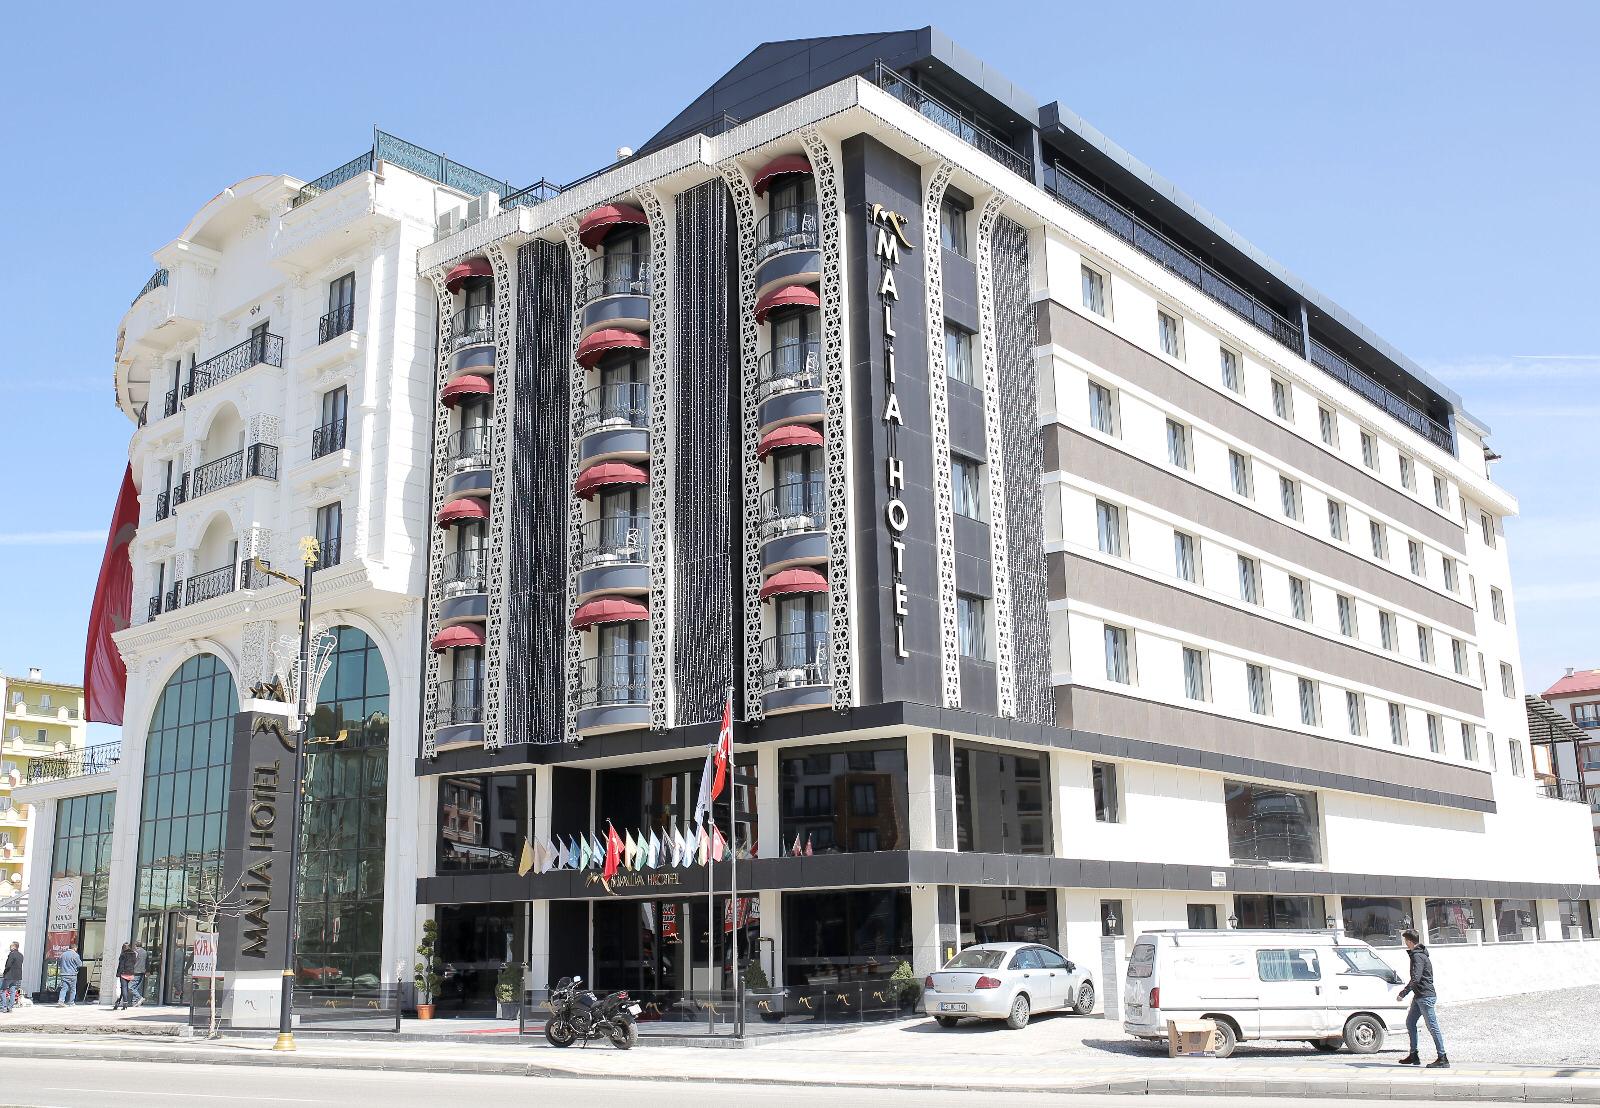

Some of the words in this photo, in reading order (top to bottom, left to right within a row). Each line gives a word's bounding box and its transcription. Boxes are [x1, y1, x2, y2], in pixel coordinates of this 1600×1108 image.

[888, 456, 909, 658] HOTEL
[250, 759, 281, 851] HOTEL
[647, 872, 683, 886] HOTEL
